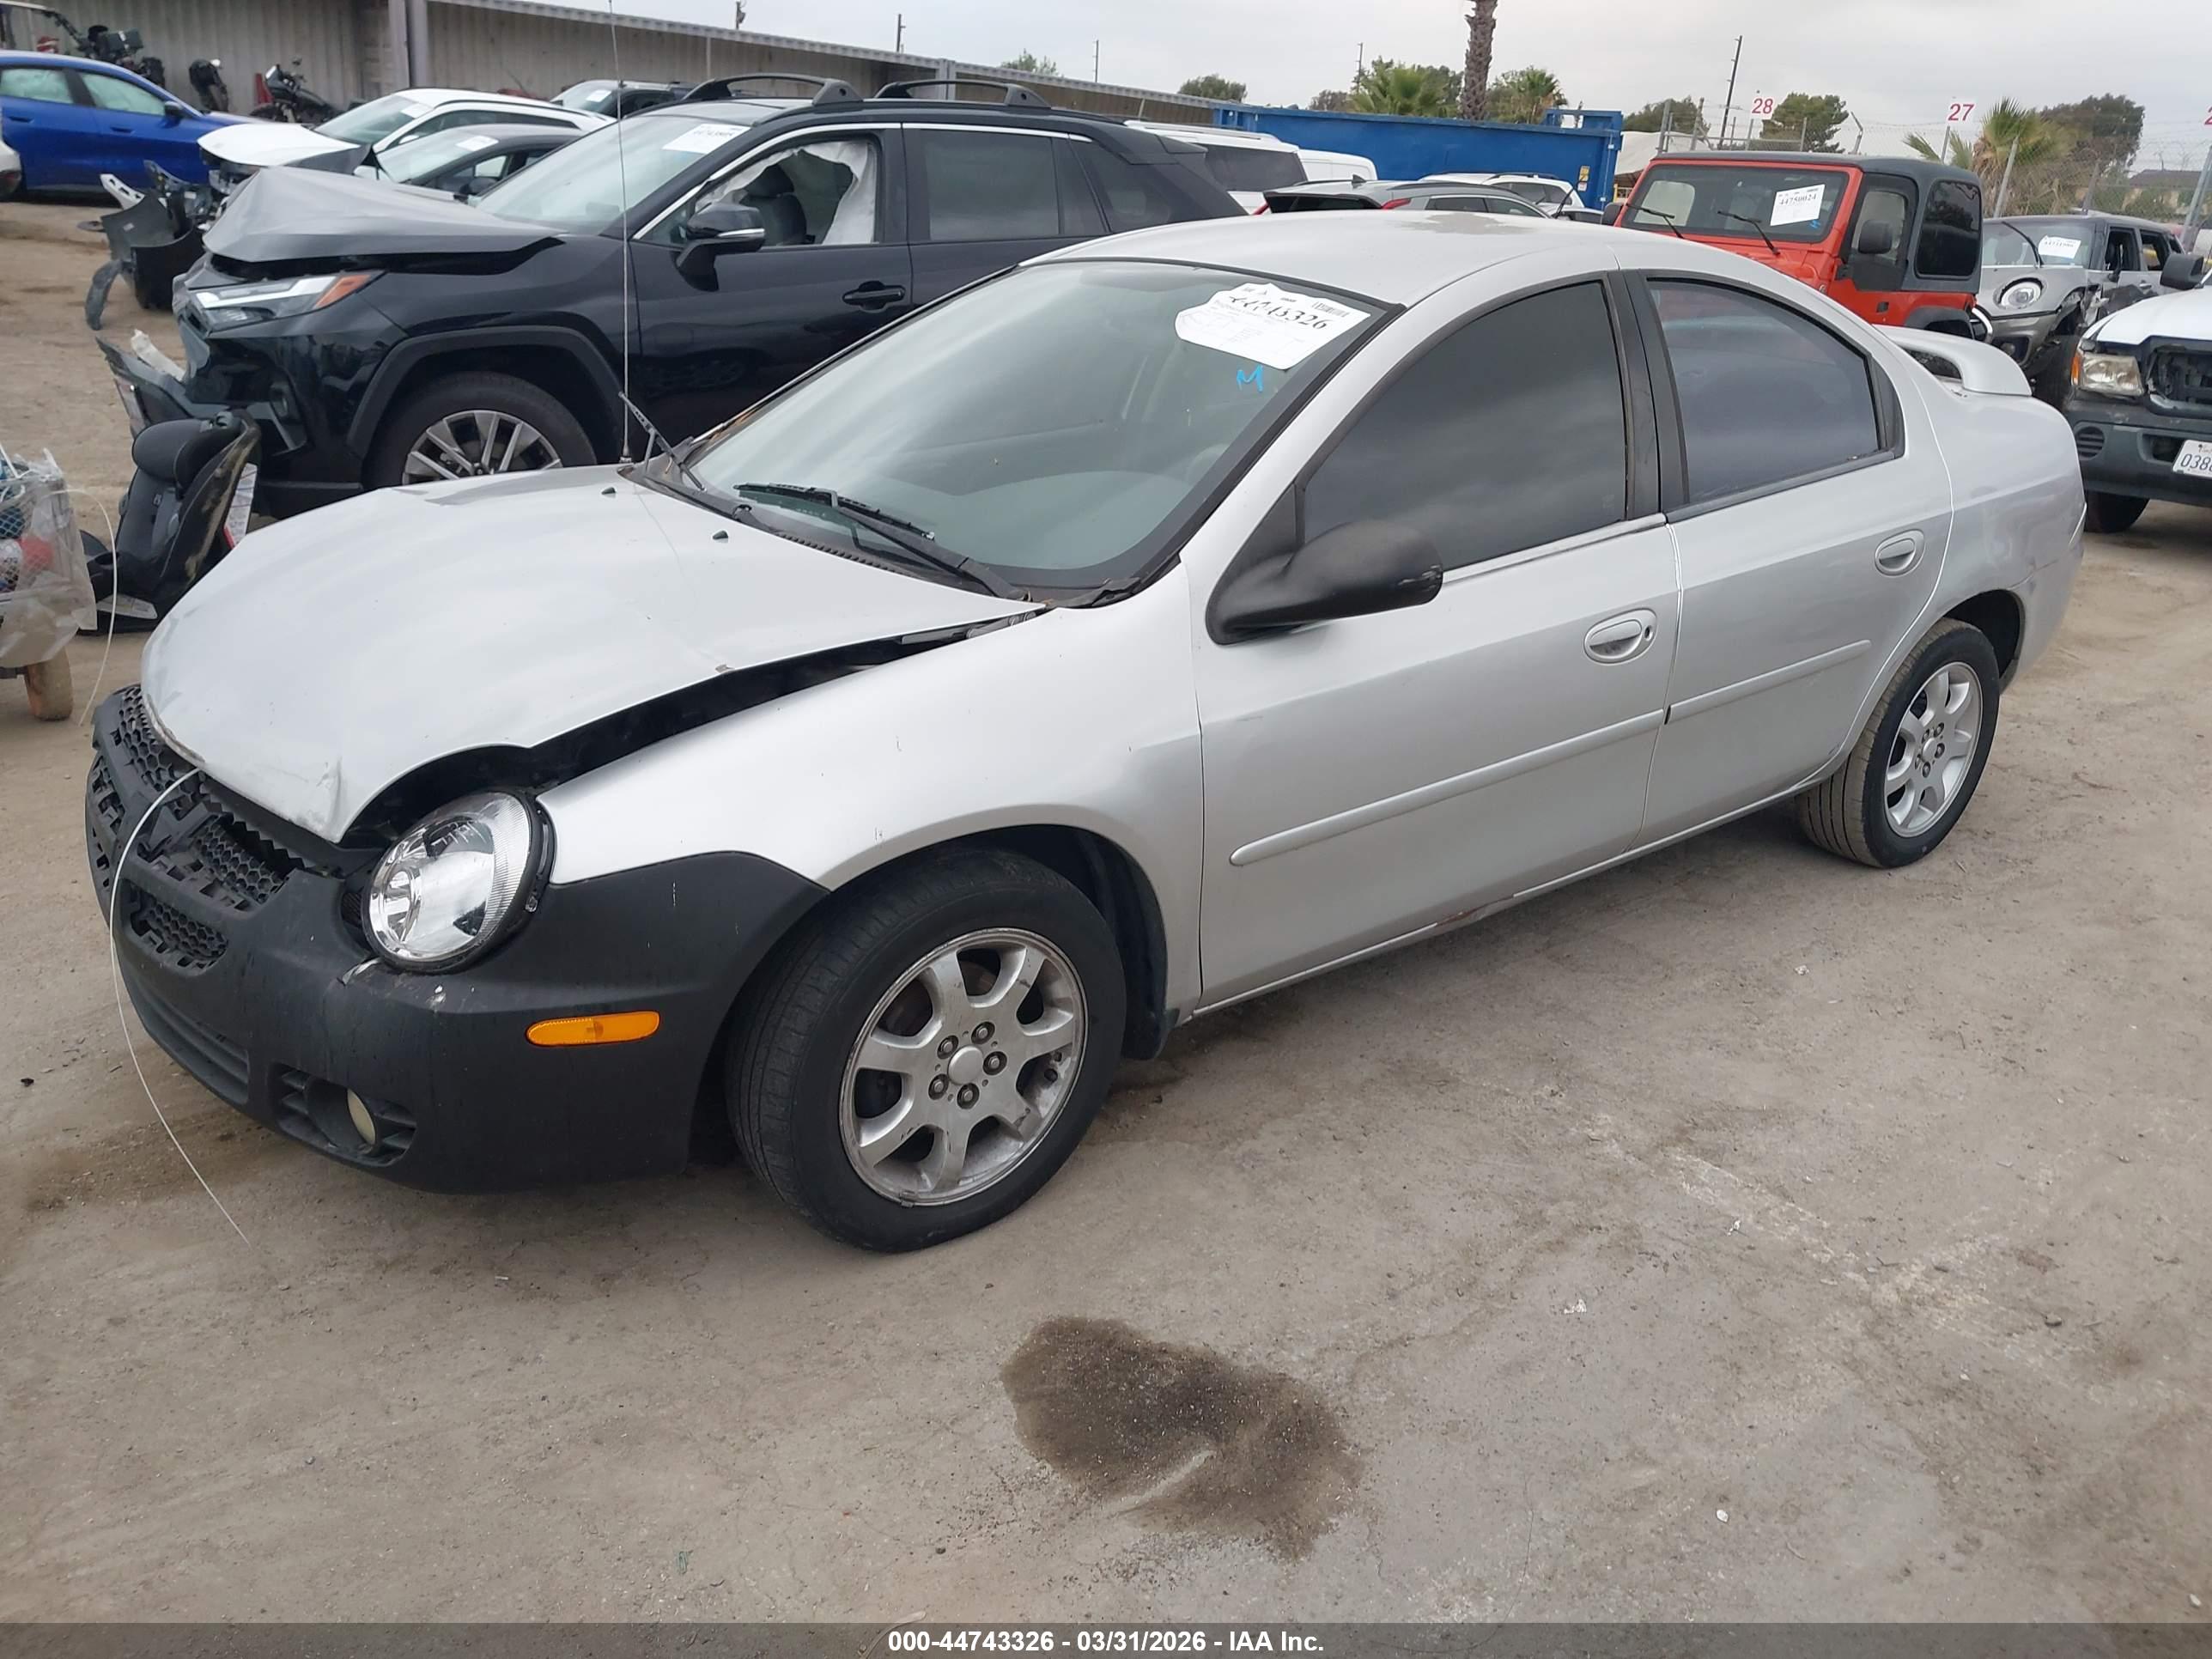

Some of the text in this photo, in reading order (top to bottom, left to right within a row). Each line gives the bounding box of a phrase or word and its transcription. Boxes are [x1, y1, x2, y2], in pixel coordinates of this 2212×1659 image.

[1752, 98, 1773, 114] 28
[1948, 103, 1974, 120] 27
[1237, 364, 1263, 392] M
